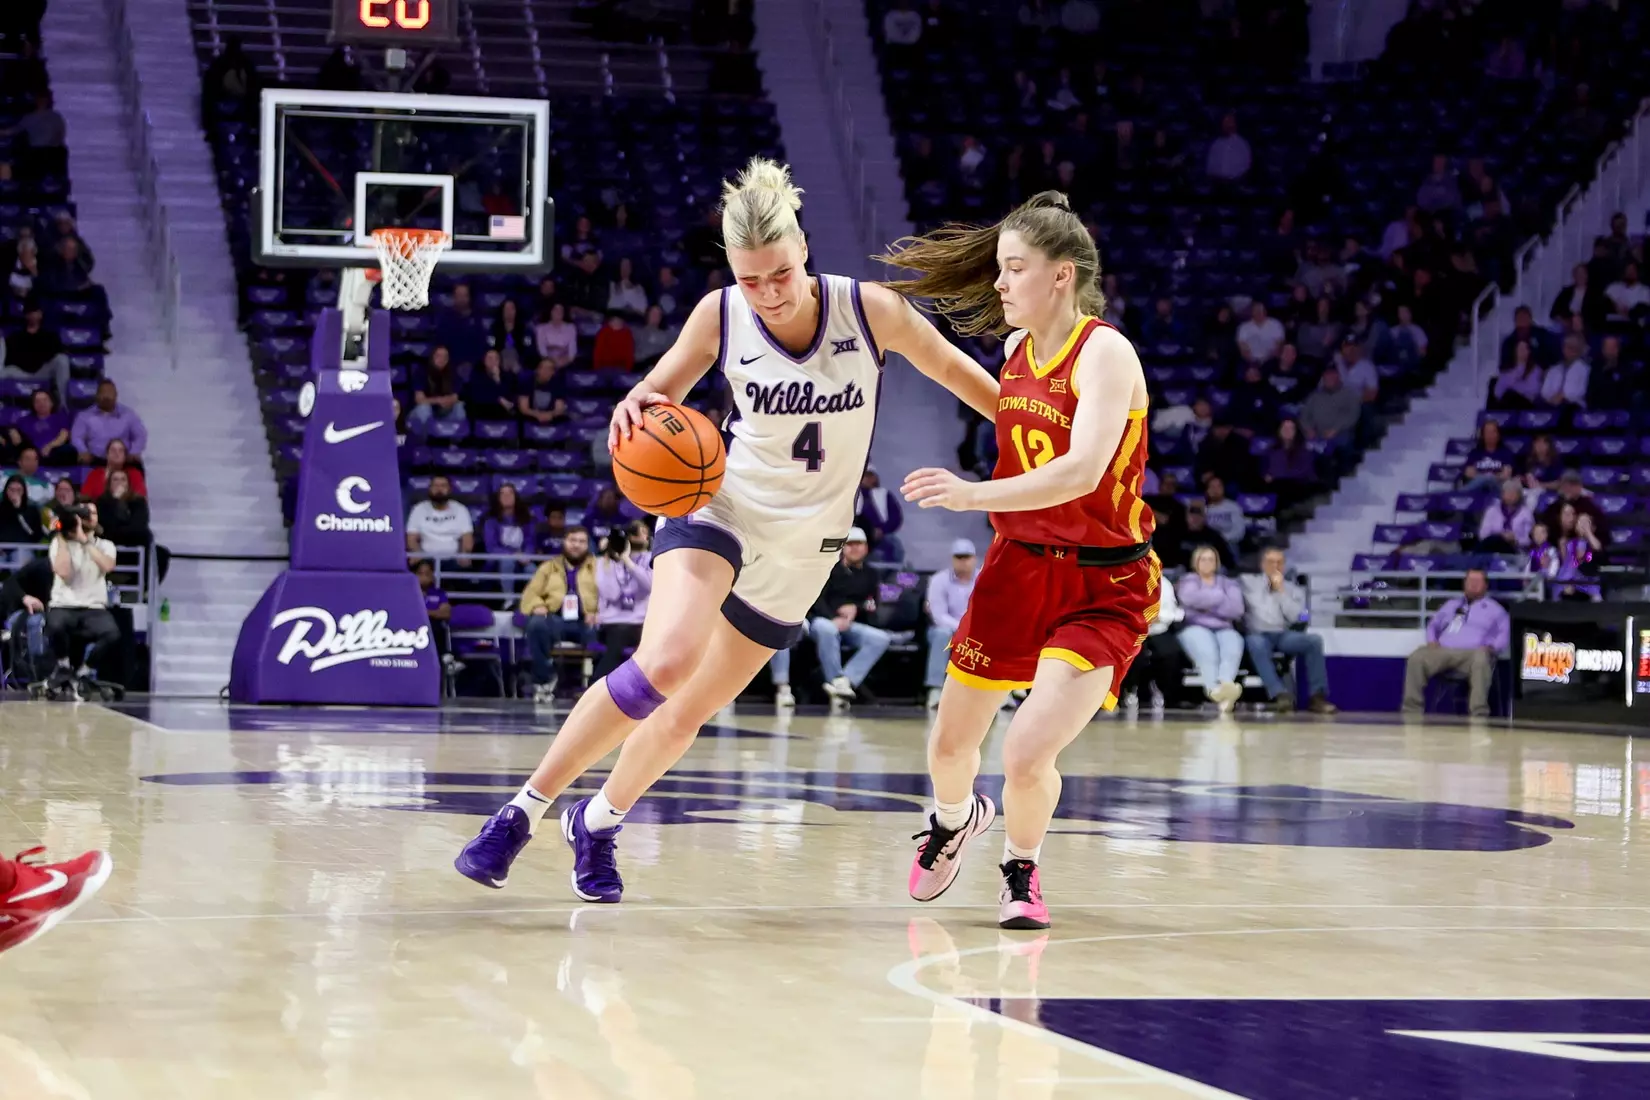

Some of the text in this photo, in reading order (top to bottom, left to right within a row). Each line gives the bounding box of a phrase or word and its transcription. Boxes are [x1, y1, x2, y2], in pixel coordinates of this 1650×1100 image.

[830, 337, 860, 356] XII
[745, 379, 865, 415] Wildcats
[998, 396, 1071, 429] IOWA STATE
[791, 421, 825, 472] 4
[271, 606, 429, 667] Dillons
[370, 658, 392, 668] FOOD
[955, 643, 991, 667] STATE
[1524, 633, 1574, 679] Briggs
